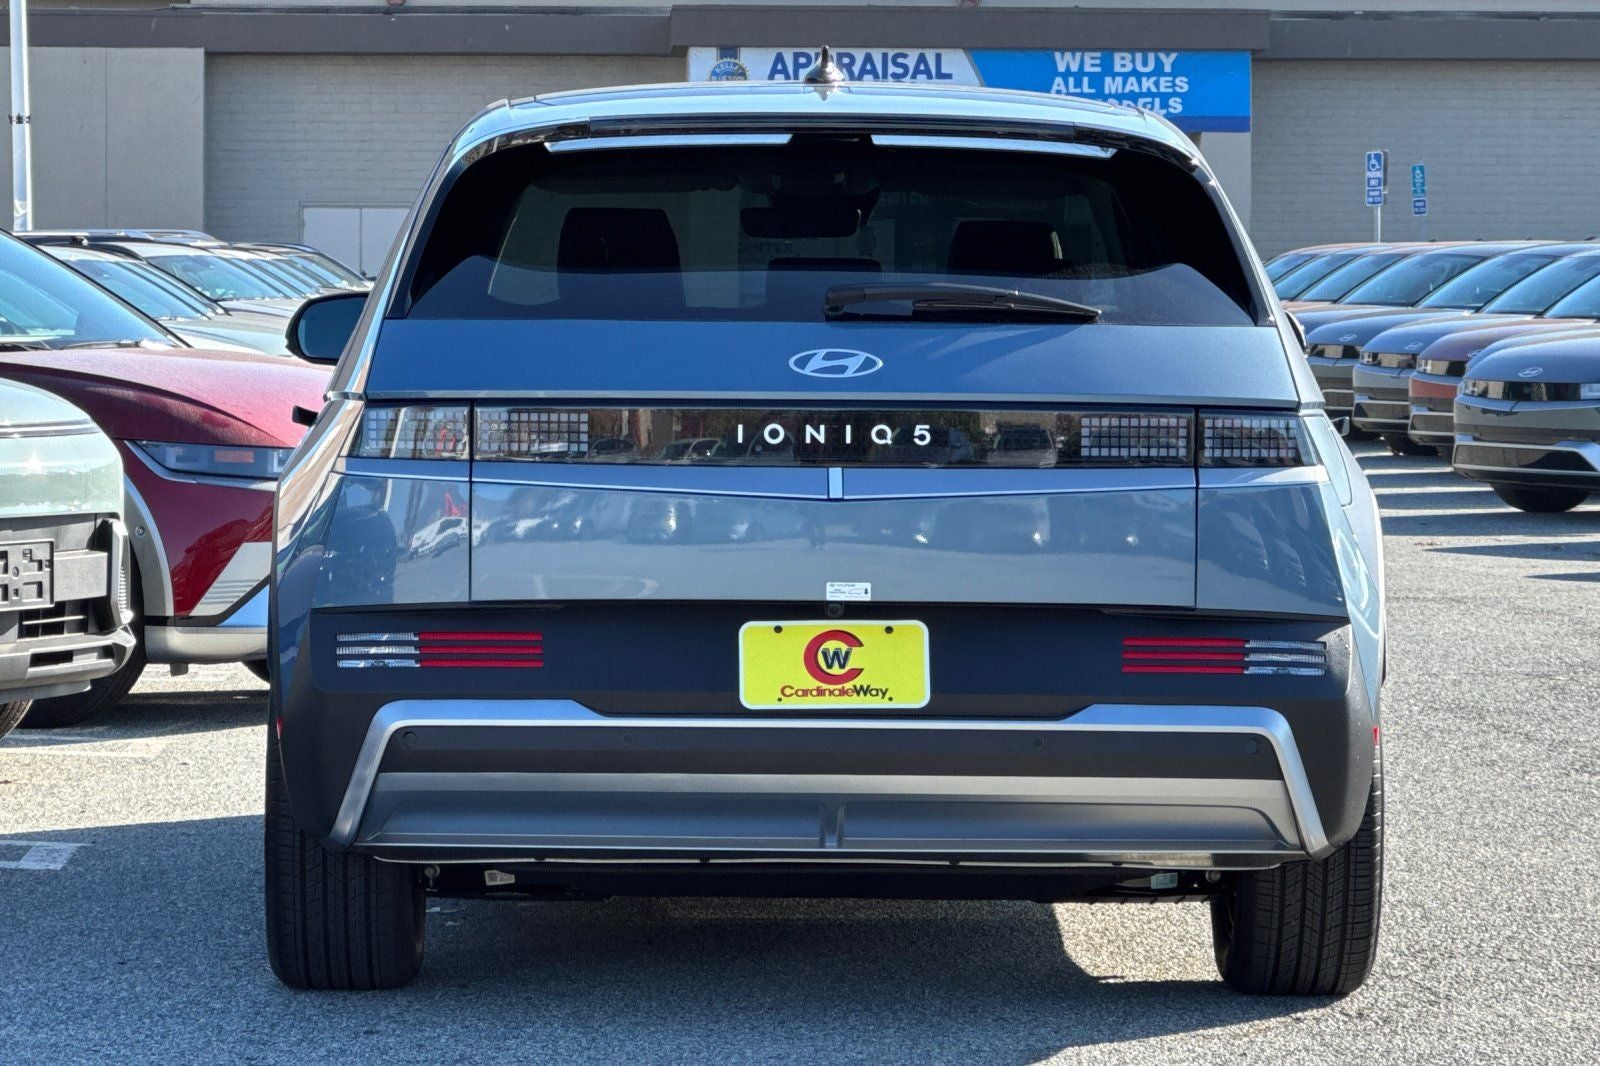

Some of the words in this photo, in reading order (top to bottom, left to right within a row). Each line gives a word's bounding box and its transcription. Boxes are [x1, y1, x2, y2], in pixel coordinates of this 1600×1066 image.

[1054, 51, 1102, 73] WE
[1113, 51, 1179, 73] BUY
[1050, 76, 1096, 94] ALL
[1104, 76, 1190, 94] MAKES
[737, 423, 893, 445] IONIQ
[913, 424, 931, 446] 5
[780, 684, 889, 700] CardinaleWay
